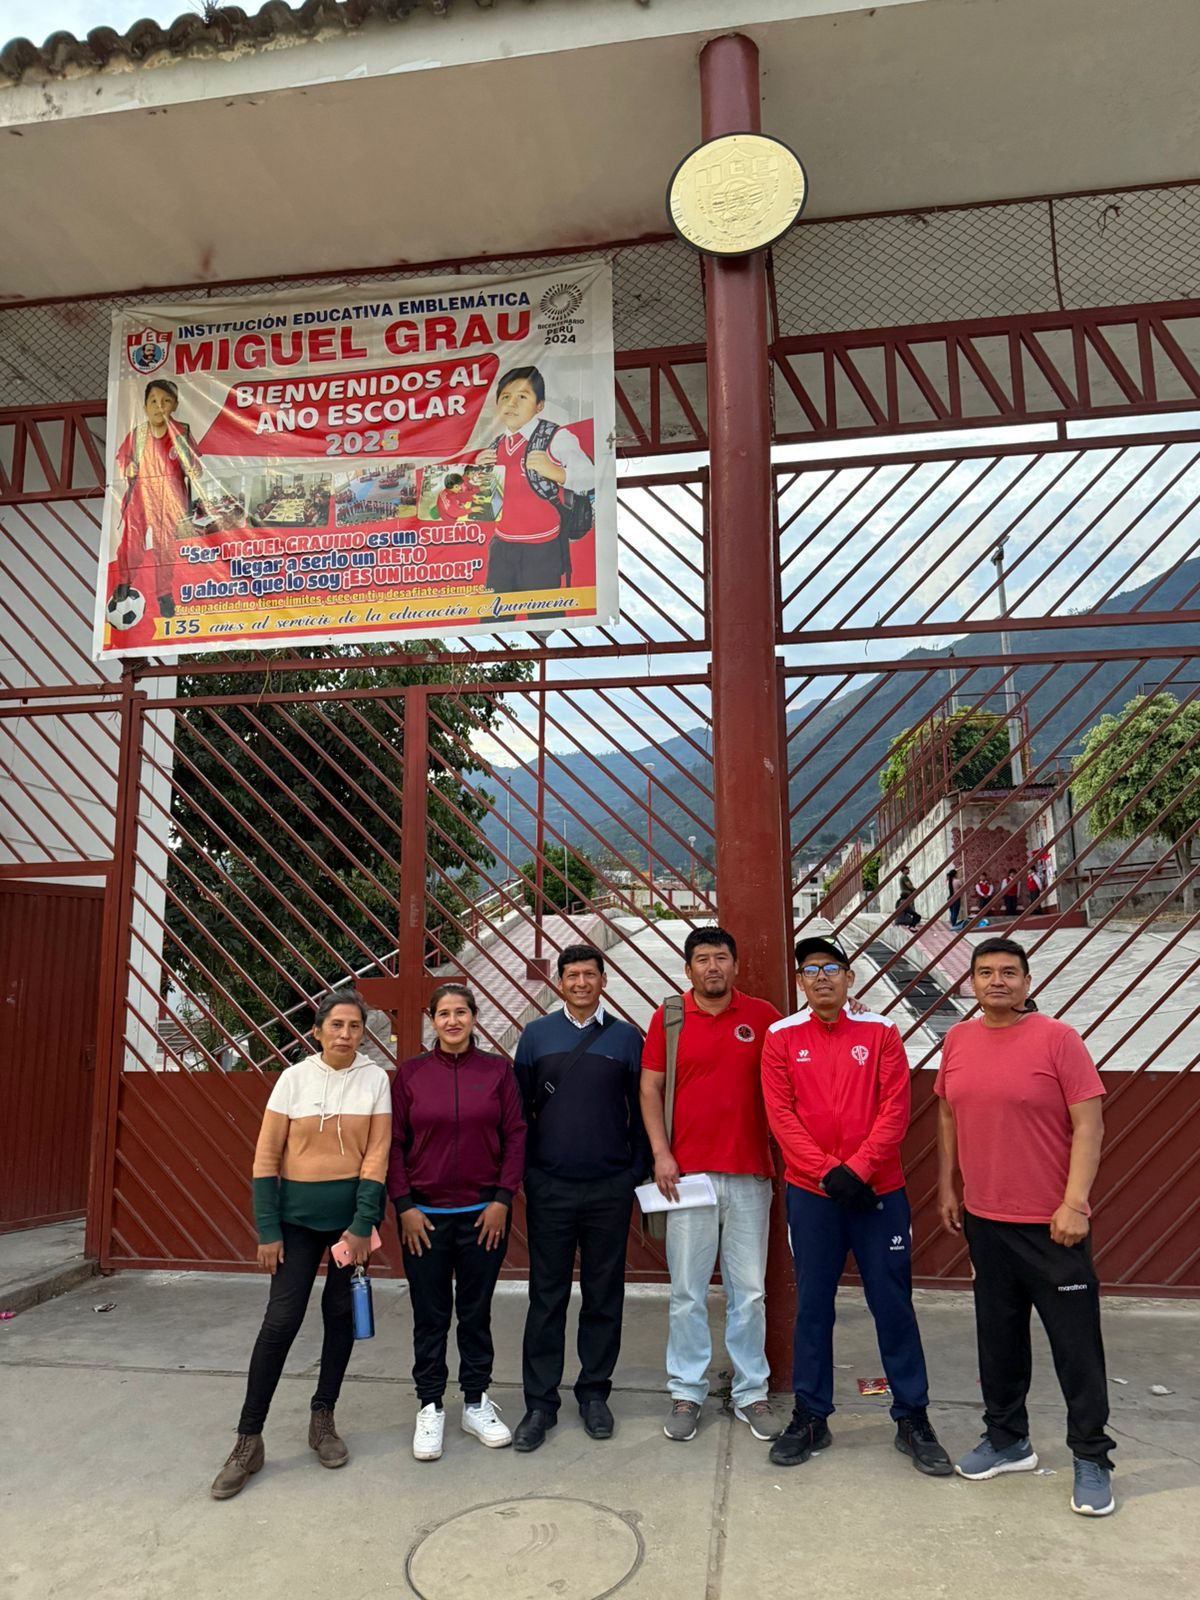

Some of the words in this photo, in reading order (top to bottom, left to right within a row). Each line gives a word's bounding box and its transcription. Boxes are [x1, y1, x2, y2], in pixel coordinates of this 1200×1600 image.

[178, 313, 288, 339] INSTITUCIÓN
[292, 304, 393, 326] EDUCATIVA
[398, 291, 531, 315] EMBLEMÁTICA
[174, 325, 368, 376] MIGUEL
[384, 310, 532, 356] GRAU
[544, 334, 577, 346] 2024
[235, 368, 443, 408] BIENVENIDOS
[449, 363, 489, 388] AL
[255, 402, 320, 435] AÑO
[326, 394, 467, 427] ESCOLAR
[222, 538, 284, 560] MIGUEL
[285, 532, 365, 554] GRAUINO
[367, 532, 390, 548] es
[392, 530, 417, 546] un
[419, 522, 486, 545] SUEÑO,
[230, 557, 283, 577] llegar
[286, 558, 298, 572] a
[300, 549, 349, 571] serlo
[351, 551, 376, 567] un
[378, 546, 427, 565] RETO
[181, 584, 194, 602] y
[195, 579, 249, 598] ahora
[251, 577, 284, 596] que
[286, 572, 305, 591] lo
[306, 572, 341, 591] soy
[374, 566, 400, 585] UN
[163, 619, 201, 636] 135
[251, 615, 270, 630] al
[276, 614, 331, 630] servicio
[338, 610, 356, 625] de
[365, 608, 381, 622] la
[388, 604, 469, 621] educación
[188, 601, 241, 615] capacidad
[242, 600, 256, 610] no
[257, 598, 284, 609] tiene
[326, 593, 350, 604] cree
[351, 592, 365, 602] en
[1057, 1283, 1088, 1292] marathon
